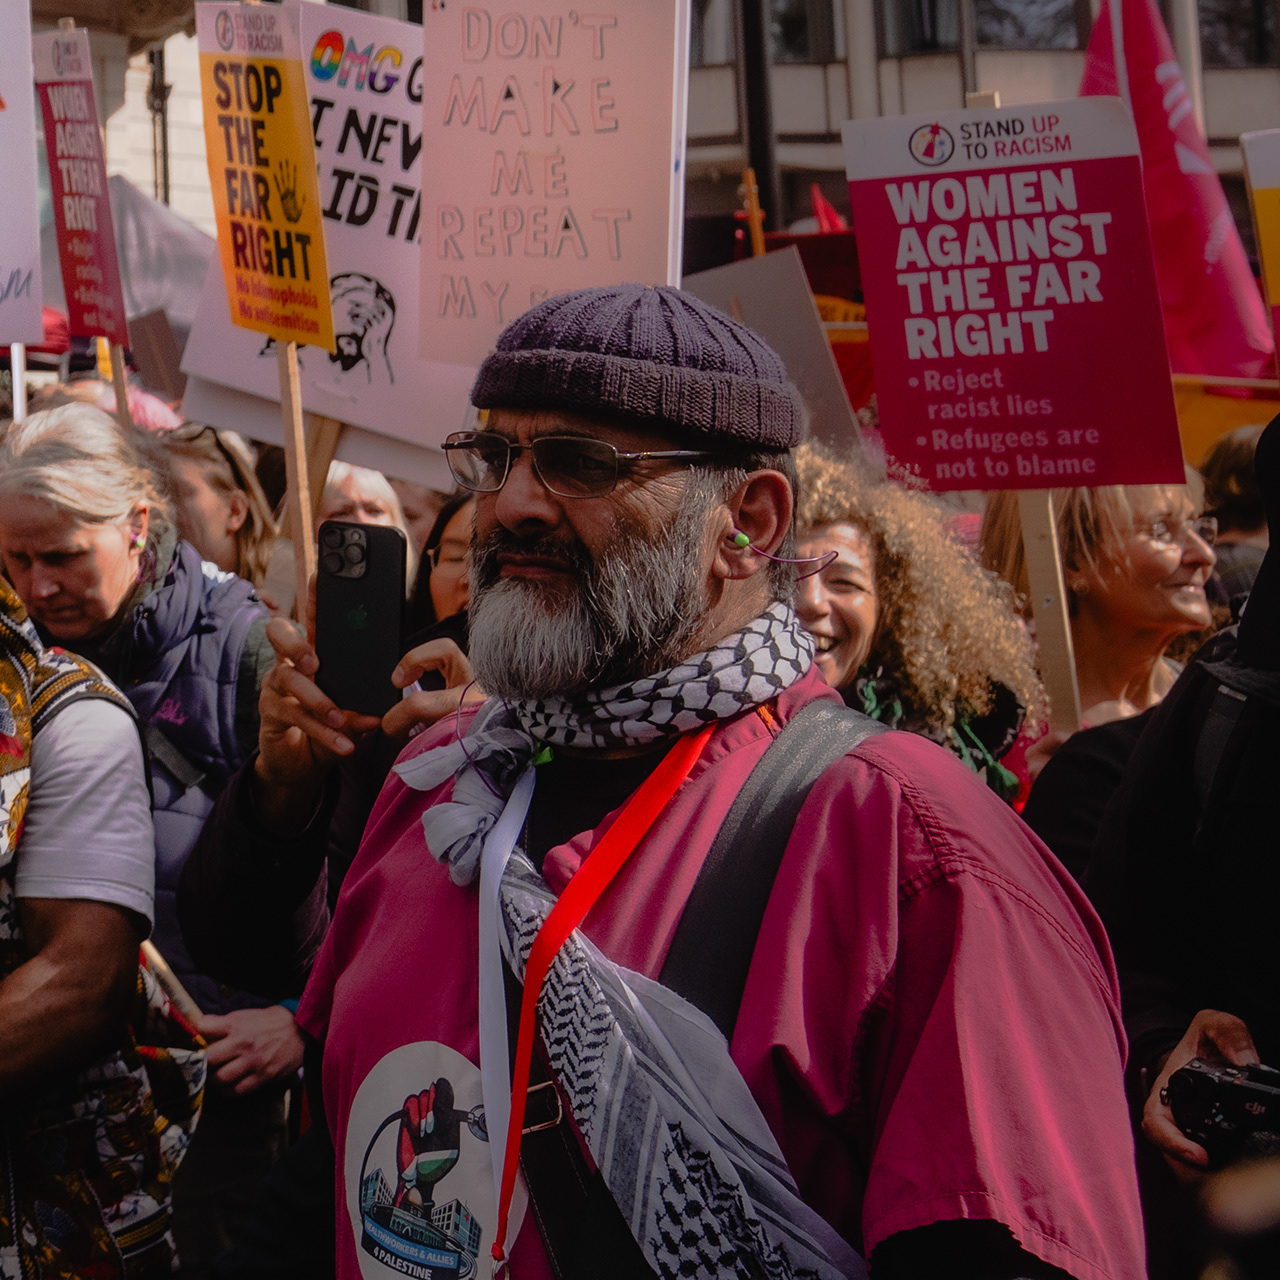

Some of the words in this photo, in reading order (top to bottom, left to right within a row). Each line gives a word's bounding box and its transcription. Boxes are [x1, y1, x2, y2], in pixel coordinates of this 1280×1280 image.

[247, 34, 284, 52] RACISM
[310, 30, 403, 94] OMG
[213, 60, 282, 113] STOP
[442, 65, 619, 137] MAKE
[217, 114, 270, 167] THE
[959, 118, 1025, 141] STAND
[1032, 114, 1060, 134] UP
[962, 142, 987, 160] TO
[993, 134, 1073, 158] RACISM
[224, 167, 273, 222] FAR
[490, 149, 569, 199] ME
[884, 168, 1078, 225] WOMEN
[229, 221, 311, 281] RIGHT
[436, 203, 632, 261] REPEAT
[895, 211, 1113, 270] AGAINST
[236, 274, 250, 294] No
[239, 298, 253, 318] No
[438, 274, 509, 324] MY
[896, 267, 995, 315] THE
[1005, 260, 1104, 308] FAR
[904, 309, 1055, 360] RIGHT
[923, 368, 1004, 396] Reject
[927, 396, 1000, 420] racist
[1007, 394, 1053, 416] lies
[931, 427, 1049, 453] Refugees
[1057, 428, 1100, 446] are
[936, 456, 977, 480] not
[984, 456, 1009, 478] to
[1016, 453, 1096, 477] blame
[364, 1220, 418, 1258] HEALTHWORKERS
[420, 1249, 426, 1258] &
[426, 1251, 454, 1267] ALLIES
[373, 1246, 379, 1257] 4
[379, 1250, 433, 1280] PALESTINE
